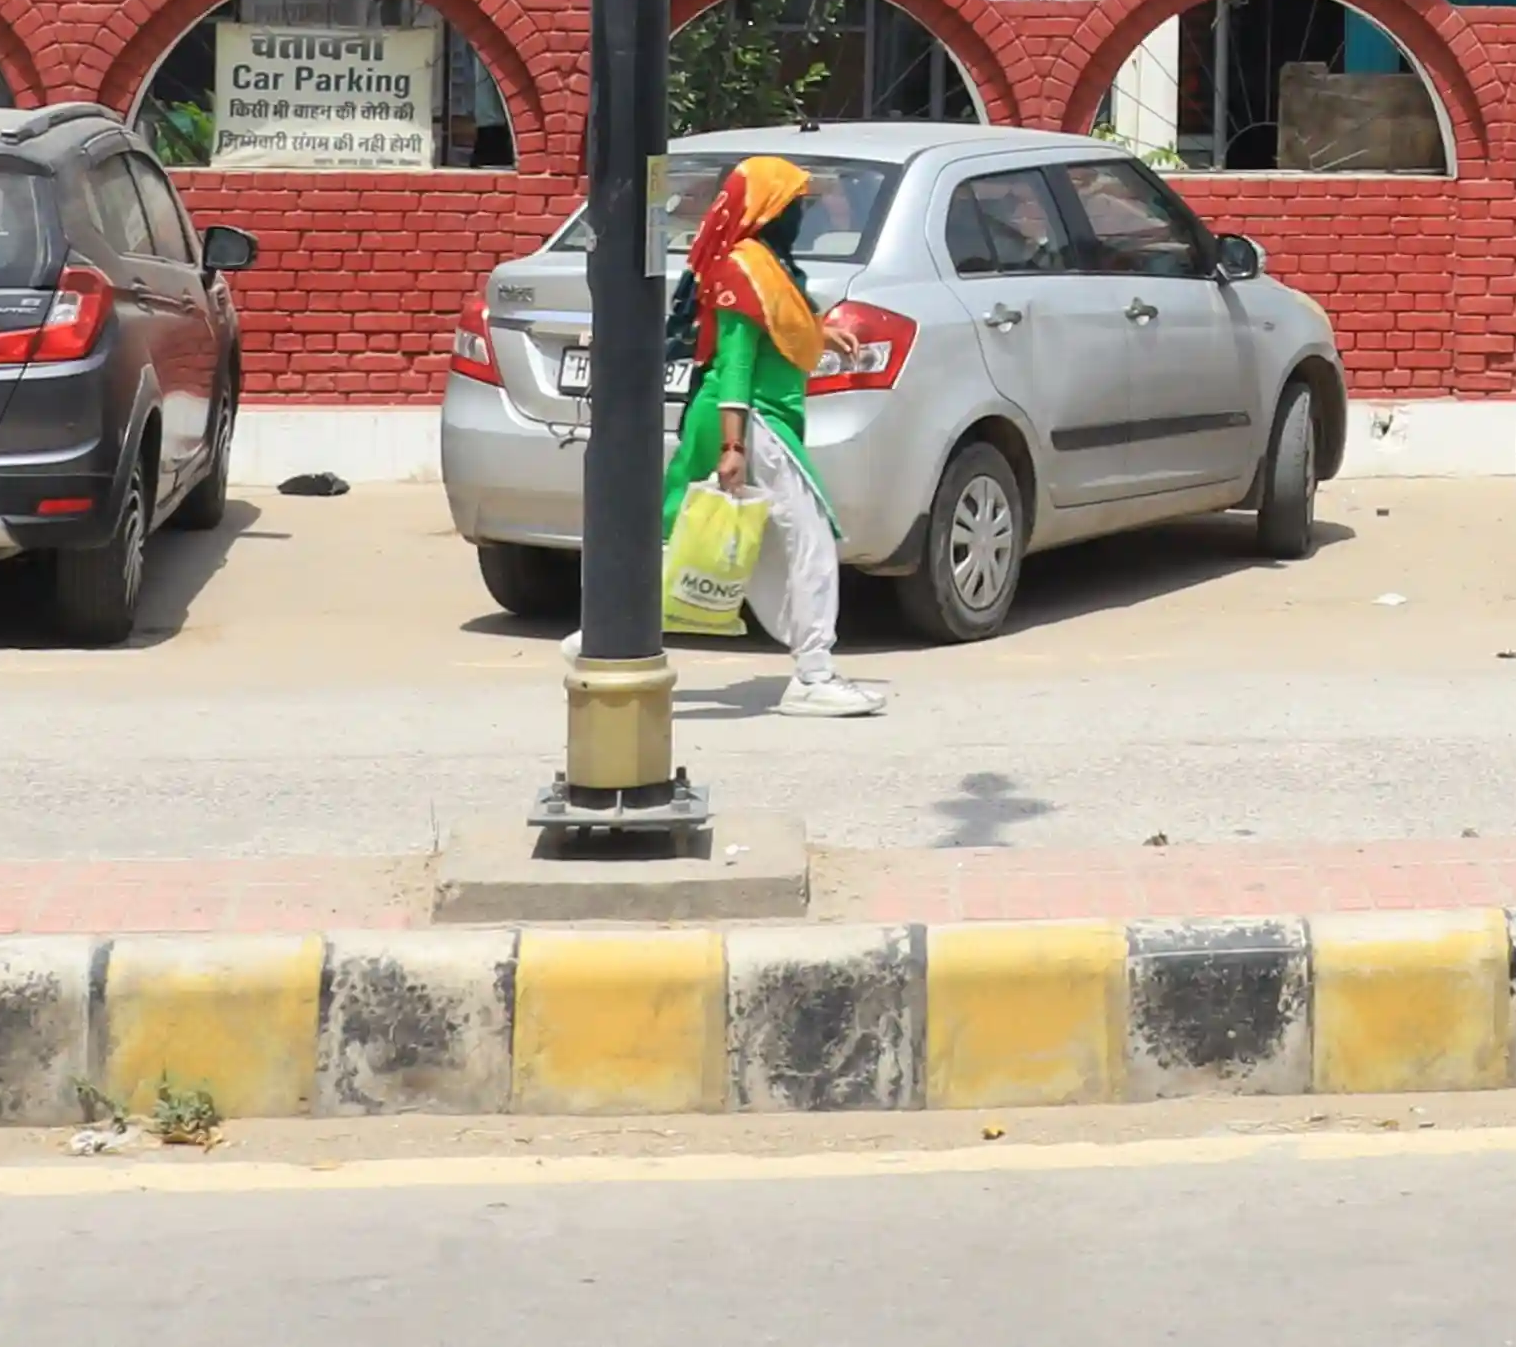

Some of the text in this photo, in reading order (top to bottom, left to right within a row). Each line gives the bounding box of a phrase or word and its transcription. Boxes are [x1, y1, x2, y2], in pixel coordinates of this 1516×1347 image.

[233, 65, 410, 99] Car Parking
[230, 98, 268, 118] किसी
[272, 99, 289, 120] भी
[394, 102, 414, 121] की
[292, 133, 329, 150] संगम
[334, 134, 354, 152] की
[390, 134, 423, 153] होगी
